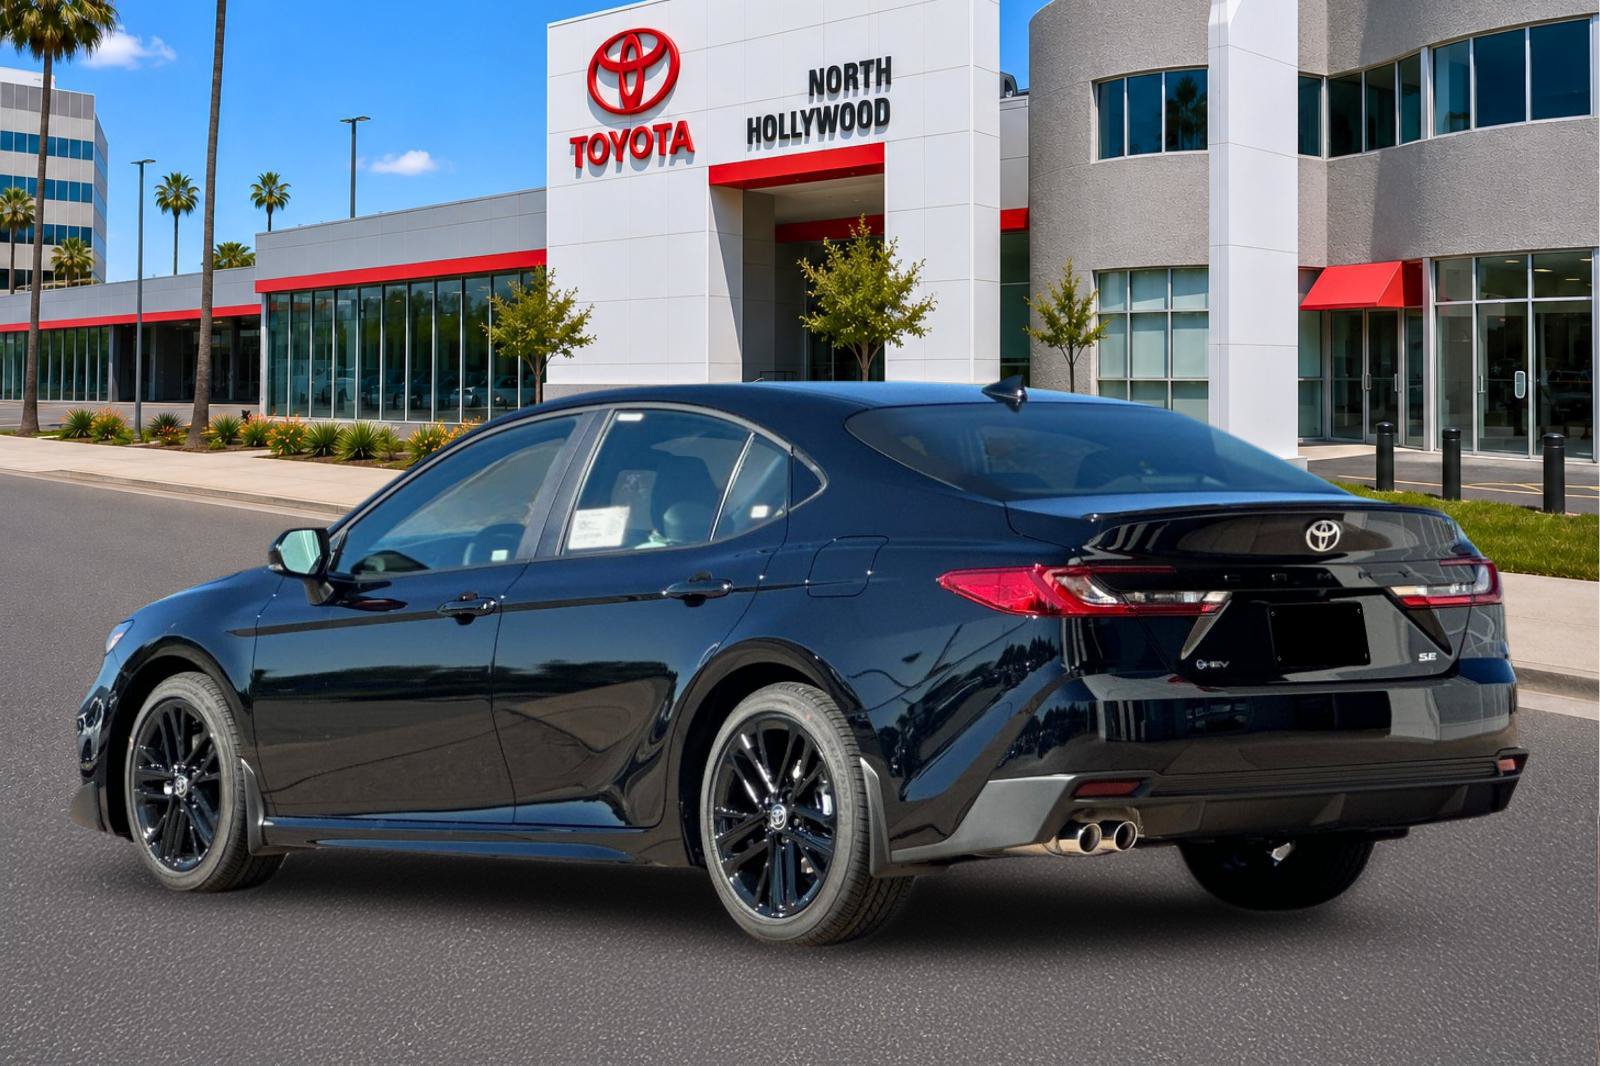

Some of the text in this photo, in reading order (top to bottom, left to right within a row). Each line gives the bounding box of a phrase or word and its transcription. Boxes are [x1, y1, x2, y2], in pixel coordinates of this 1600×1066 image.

[809, 55, 892, 97] NORTH
[746, 97, 891, 145] HOLLYWOOD
[569, 120, 695, 169] TOYOTA
[1418, 652, 1438, 662] SE
